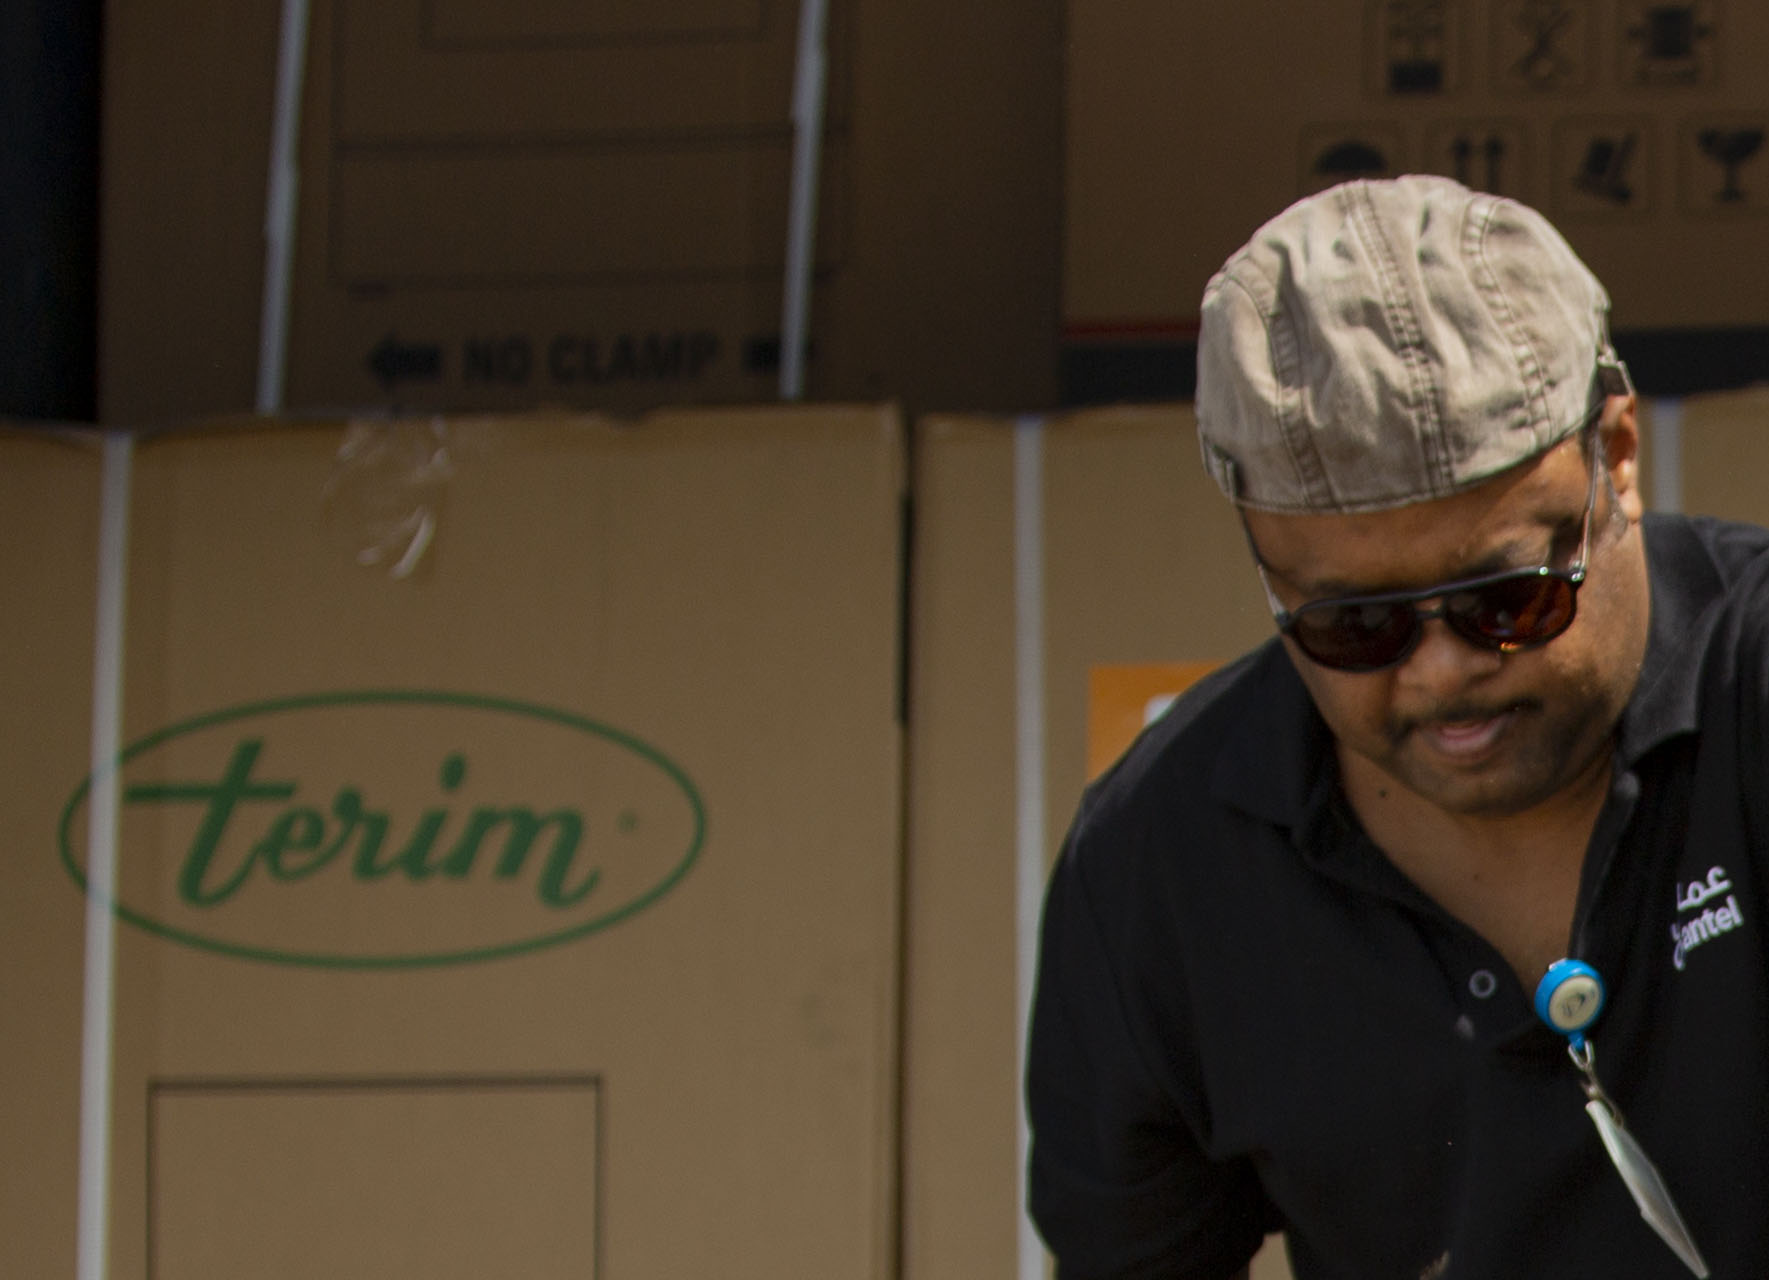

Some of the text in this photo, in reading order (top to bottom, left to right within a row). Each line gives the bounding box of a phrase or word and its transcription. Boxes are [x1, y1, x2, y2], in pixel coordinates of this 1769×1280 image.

[461, 331, 721, 387] NO CLAMP
[121, 736, 601, 910] terim
[1674, 894, 1744, 969] antel
